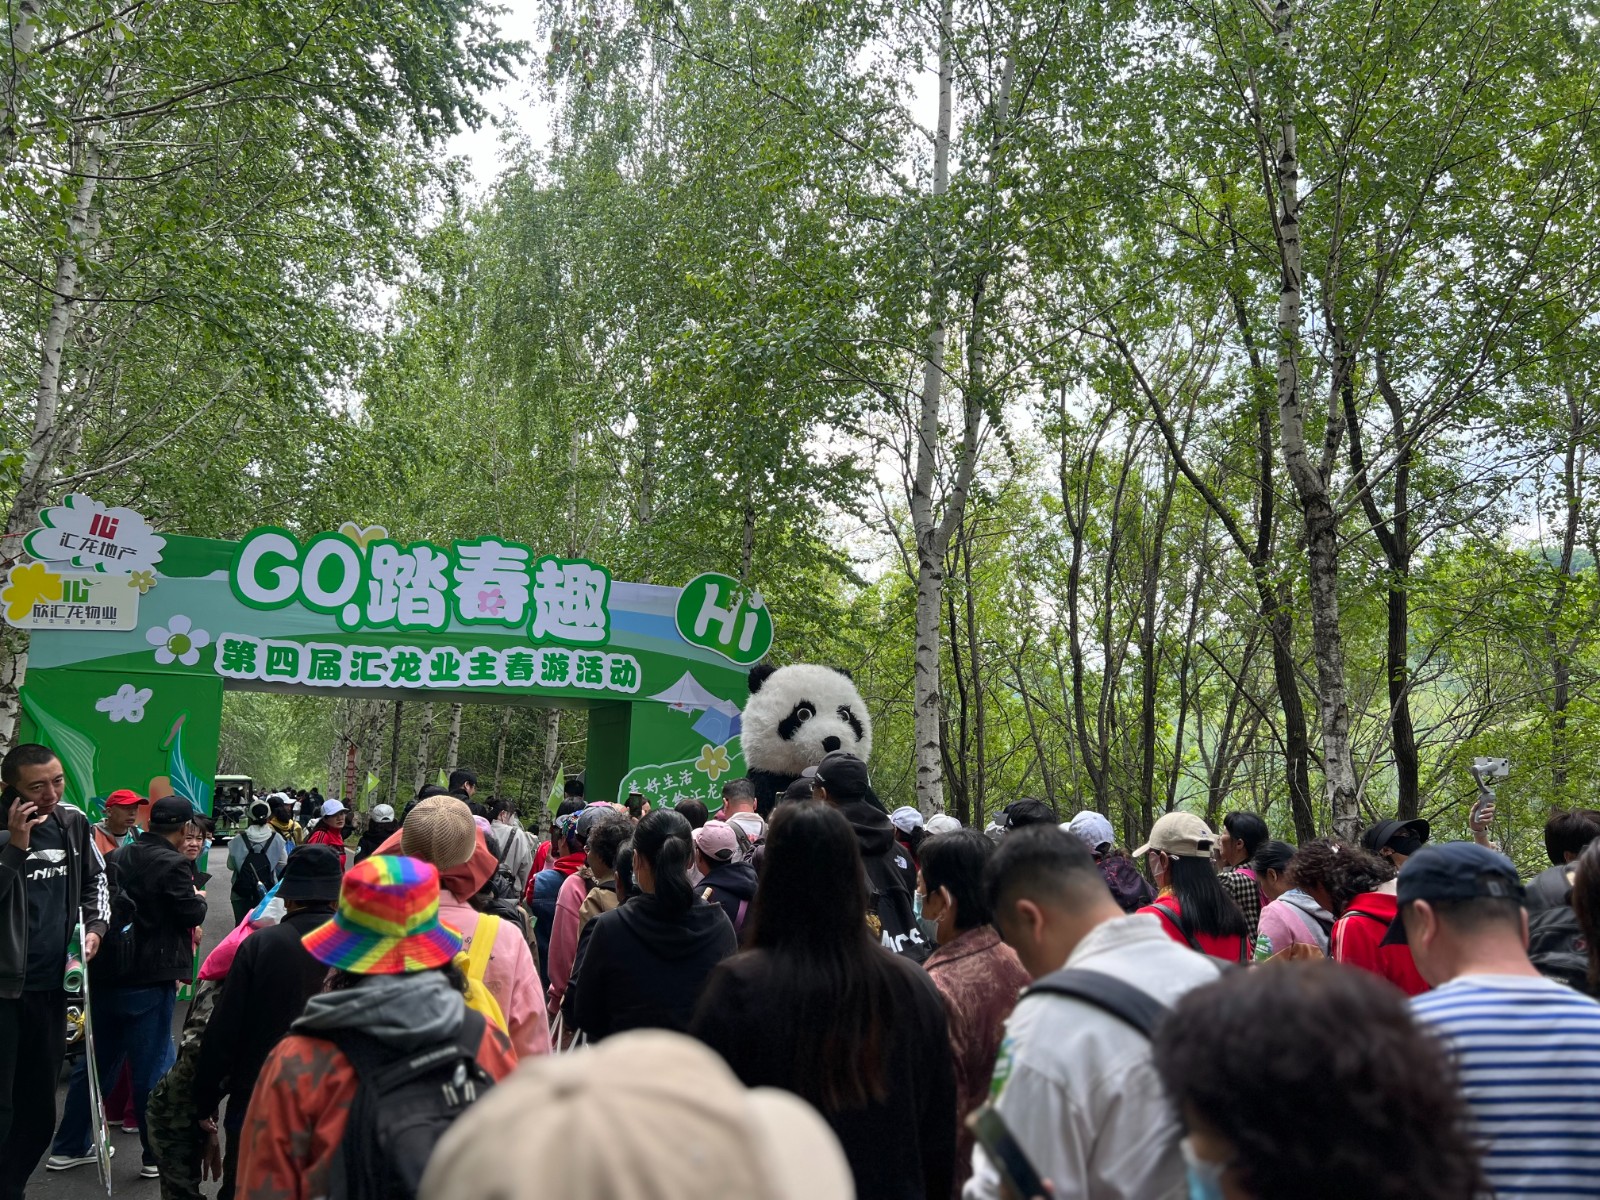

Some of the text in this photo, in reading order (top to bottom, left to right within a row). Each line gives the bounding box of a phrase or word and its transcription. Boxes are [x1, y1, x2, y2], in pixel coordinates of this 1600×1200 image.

[59, 532, 138, 560] 汇龙地产
[33, 604, 117, 619] 欣汇龙物业
[694, 582, 764, 652] Hi
[221, 638, 639, 689] 第四届汇龙业主春游活动
[657, 780, 732, 809] 交给汇龙
